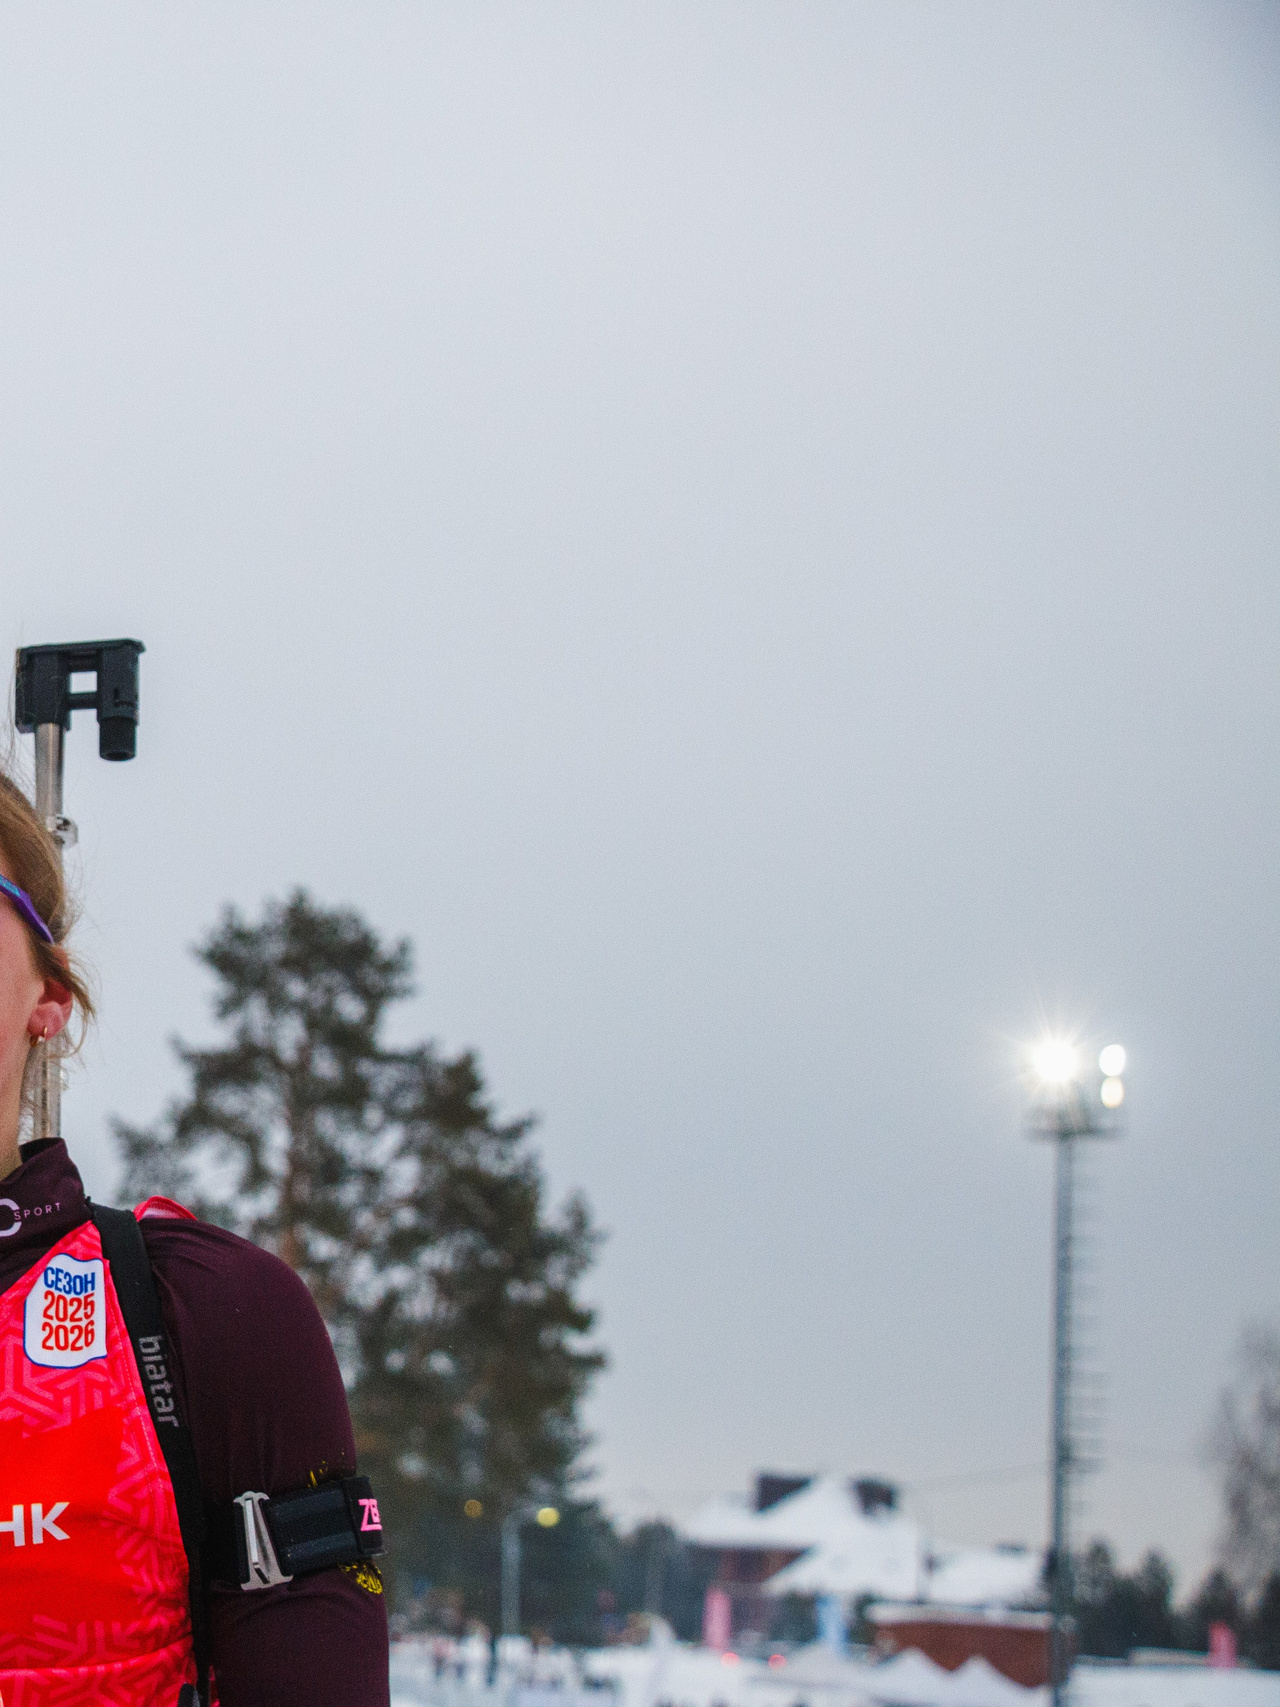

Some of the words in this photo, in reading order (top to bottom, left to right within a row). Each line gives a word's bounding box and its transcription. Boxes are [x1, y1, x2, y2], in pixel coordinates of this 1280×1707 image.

[13, 1202, 61, 1221] SPORT
[43, 1266, 96, 1296] СЕЗОН
[42, 1290, 96, 1323] 2025
[41, 1319, 96, 1352] 2026
[138, 1334, 180, 1428] biatar
